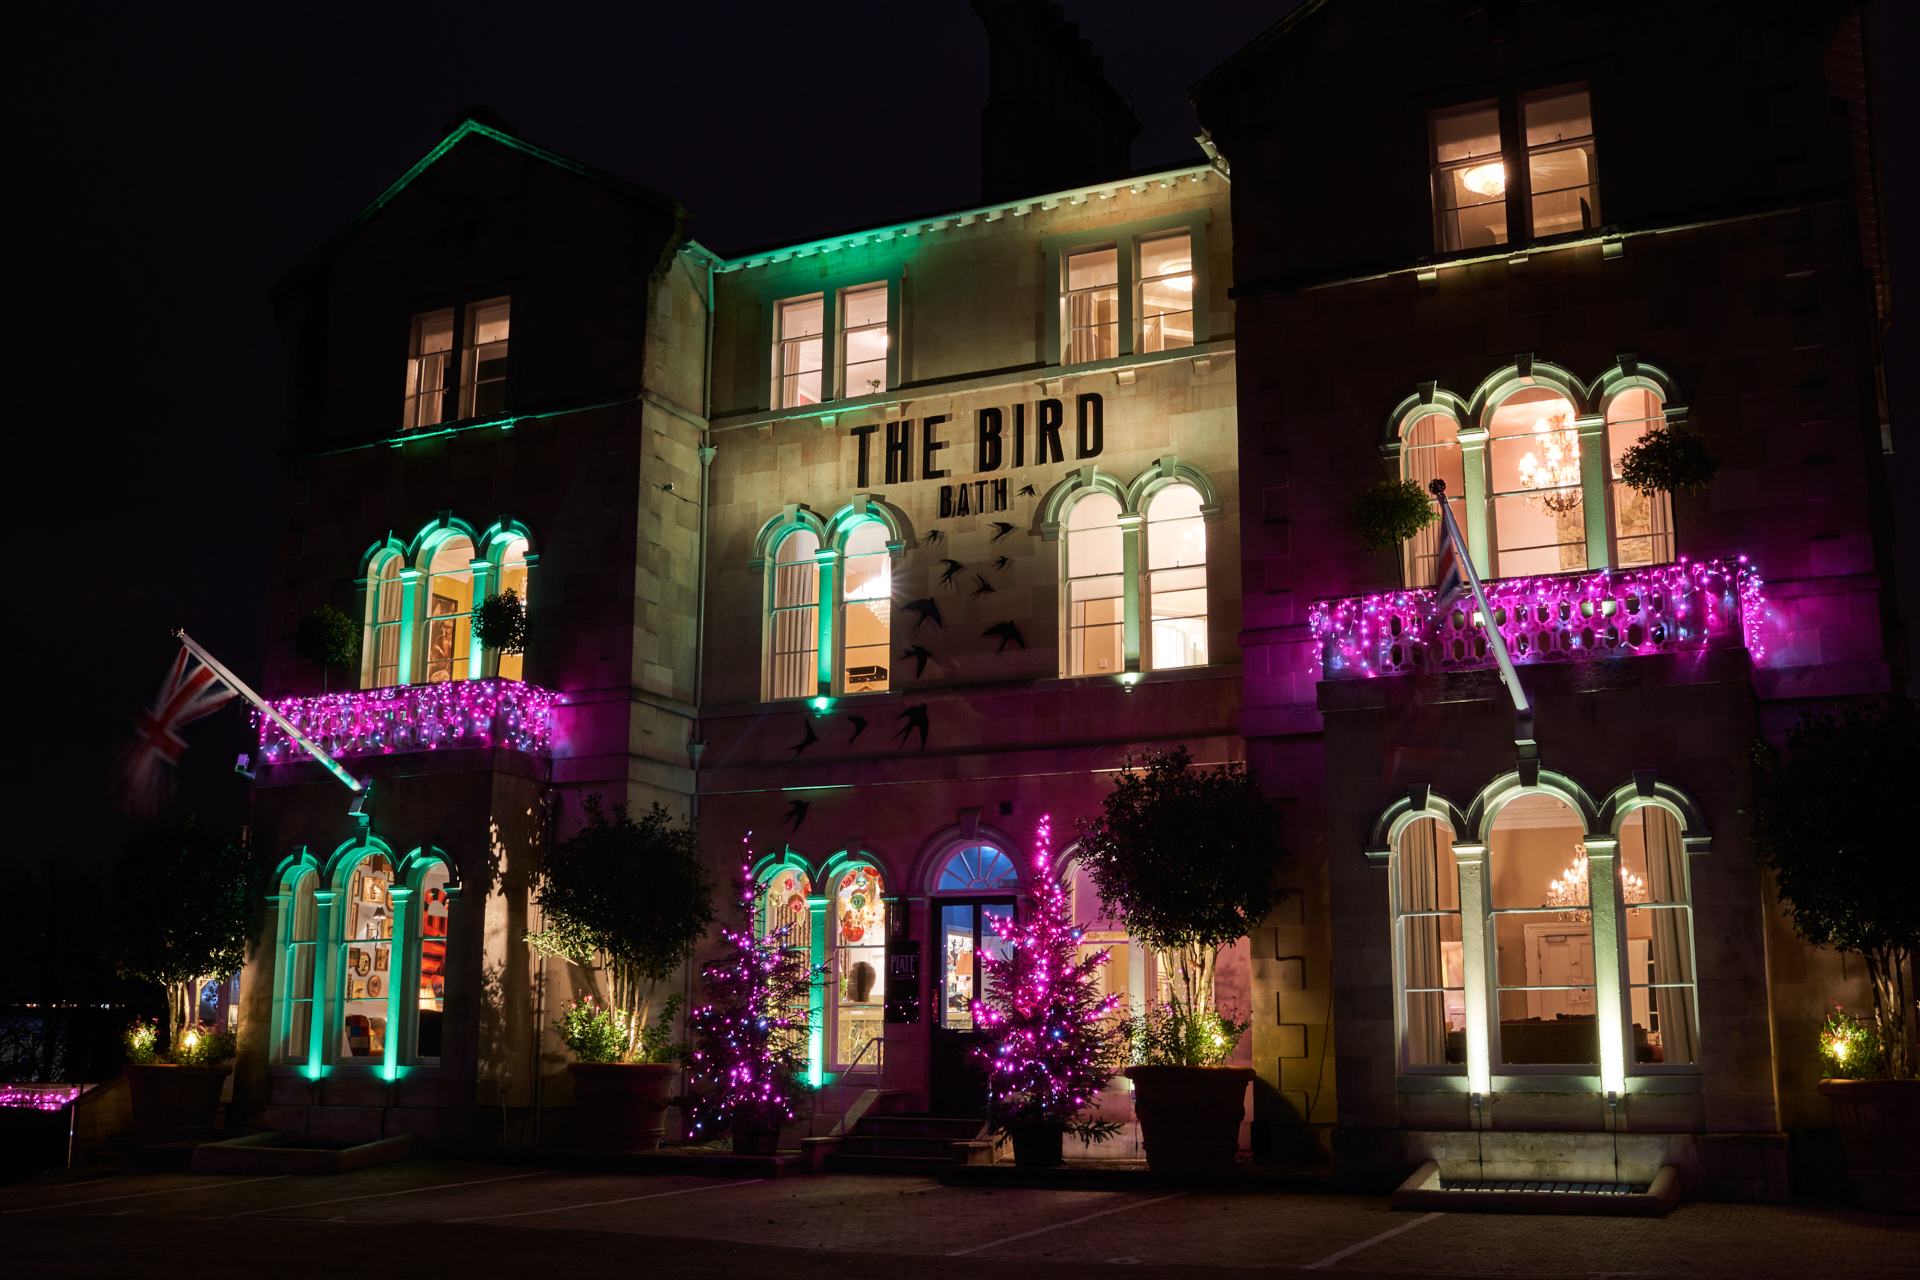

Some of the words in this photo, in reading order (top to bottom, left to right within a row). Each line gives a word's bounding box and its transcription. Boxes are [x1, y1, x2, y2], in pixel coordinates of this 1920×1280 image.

[850, 415, 946, 488] THE
[979, 392, 1104, 473] BIRD
[940, 478, 1007, 518] BATH
[890, 954, 916, 973] PLATE
